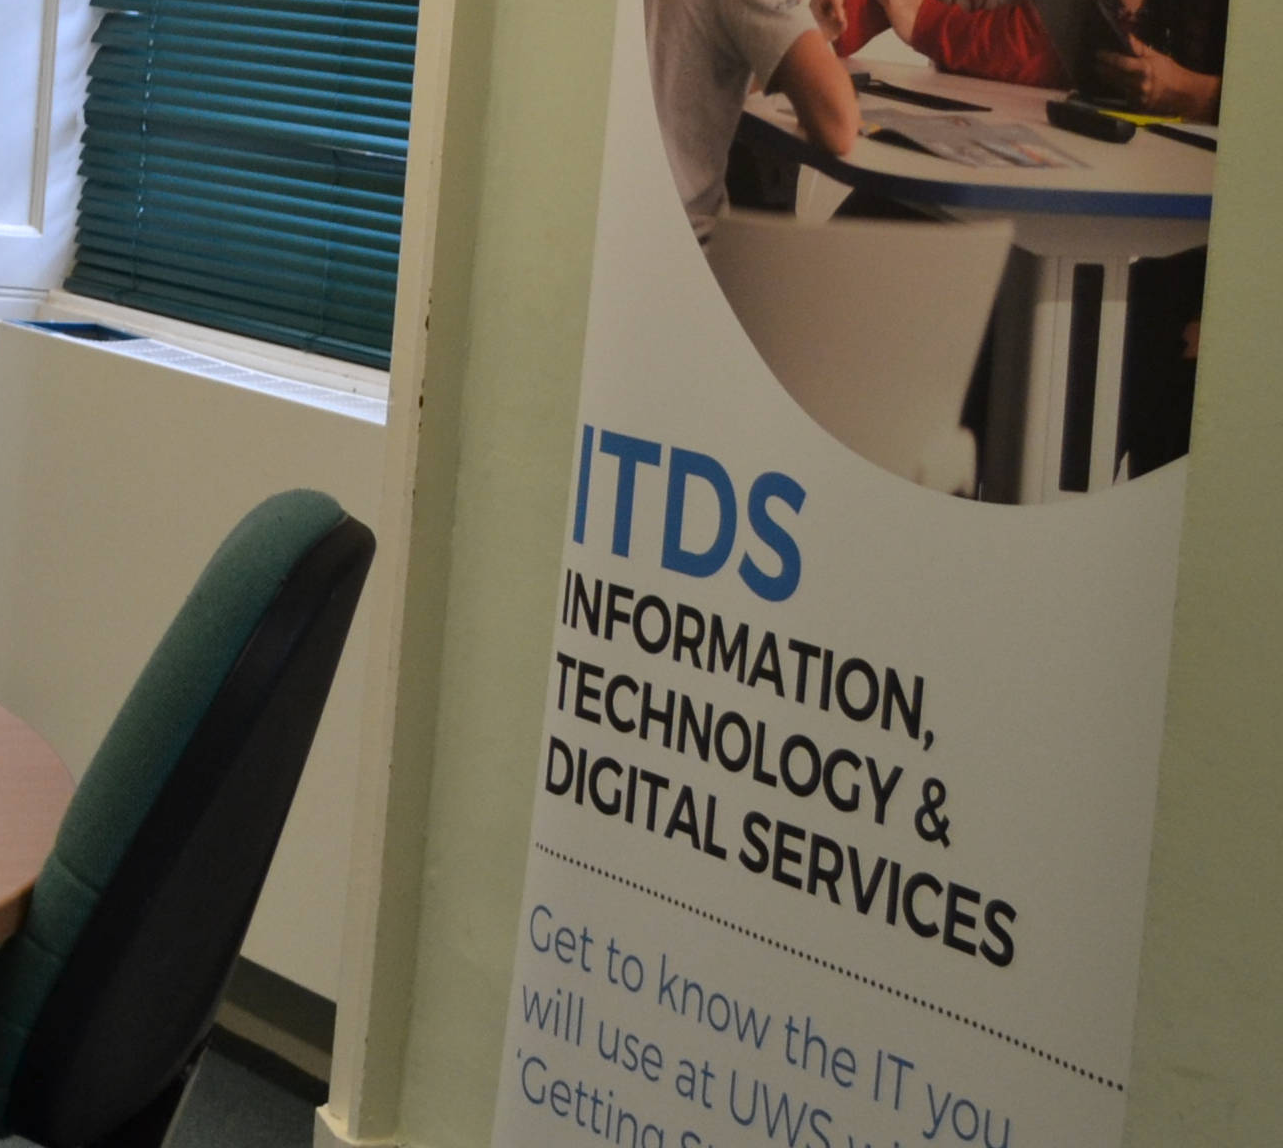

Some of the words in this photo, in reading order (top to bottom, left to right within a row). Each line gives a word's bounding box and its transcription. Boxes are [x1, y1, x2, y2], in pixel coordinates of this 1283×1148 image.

[573, 424, 807, 603] ITDS
[557, 651, 904, 826] TECHNOLOGY
[914, 777, 951, 850] &
[562, 568, 934, 752] INFORMATION,
[545, 734, 728, 862] DIGITAL
[738, 810, 1018, 968] SERVICES
[523, 984, 584, 1046] will
[598, 1020, 664, 1083] use
[675, 1059, 715, 1109] at
[730, 1069, 832, 1148] UWS
[530, 905, 594, 973] Get
[607, 938, 644, 992] to
[658, 953, 771, 1050] know
[785, 1015, 856, 1088] the
[874, 1049, 915, 1111] IT
[922, 1083, 1010, 1148] you
